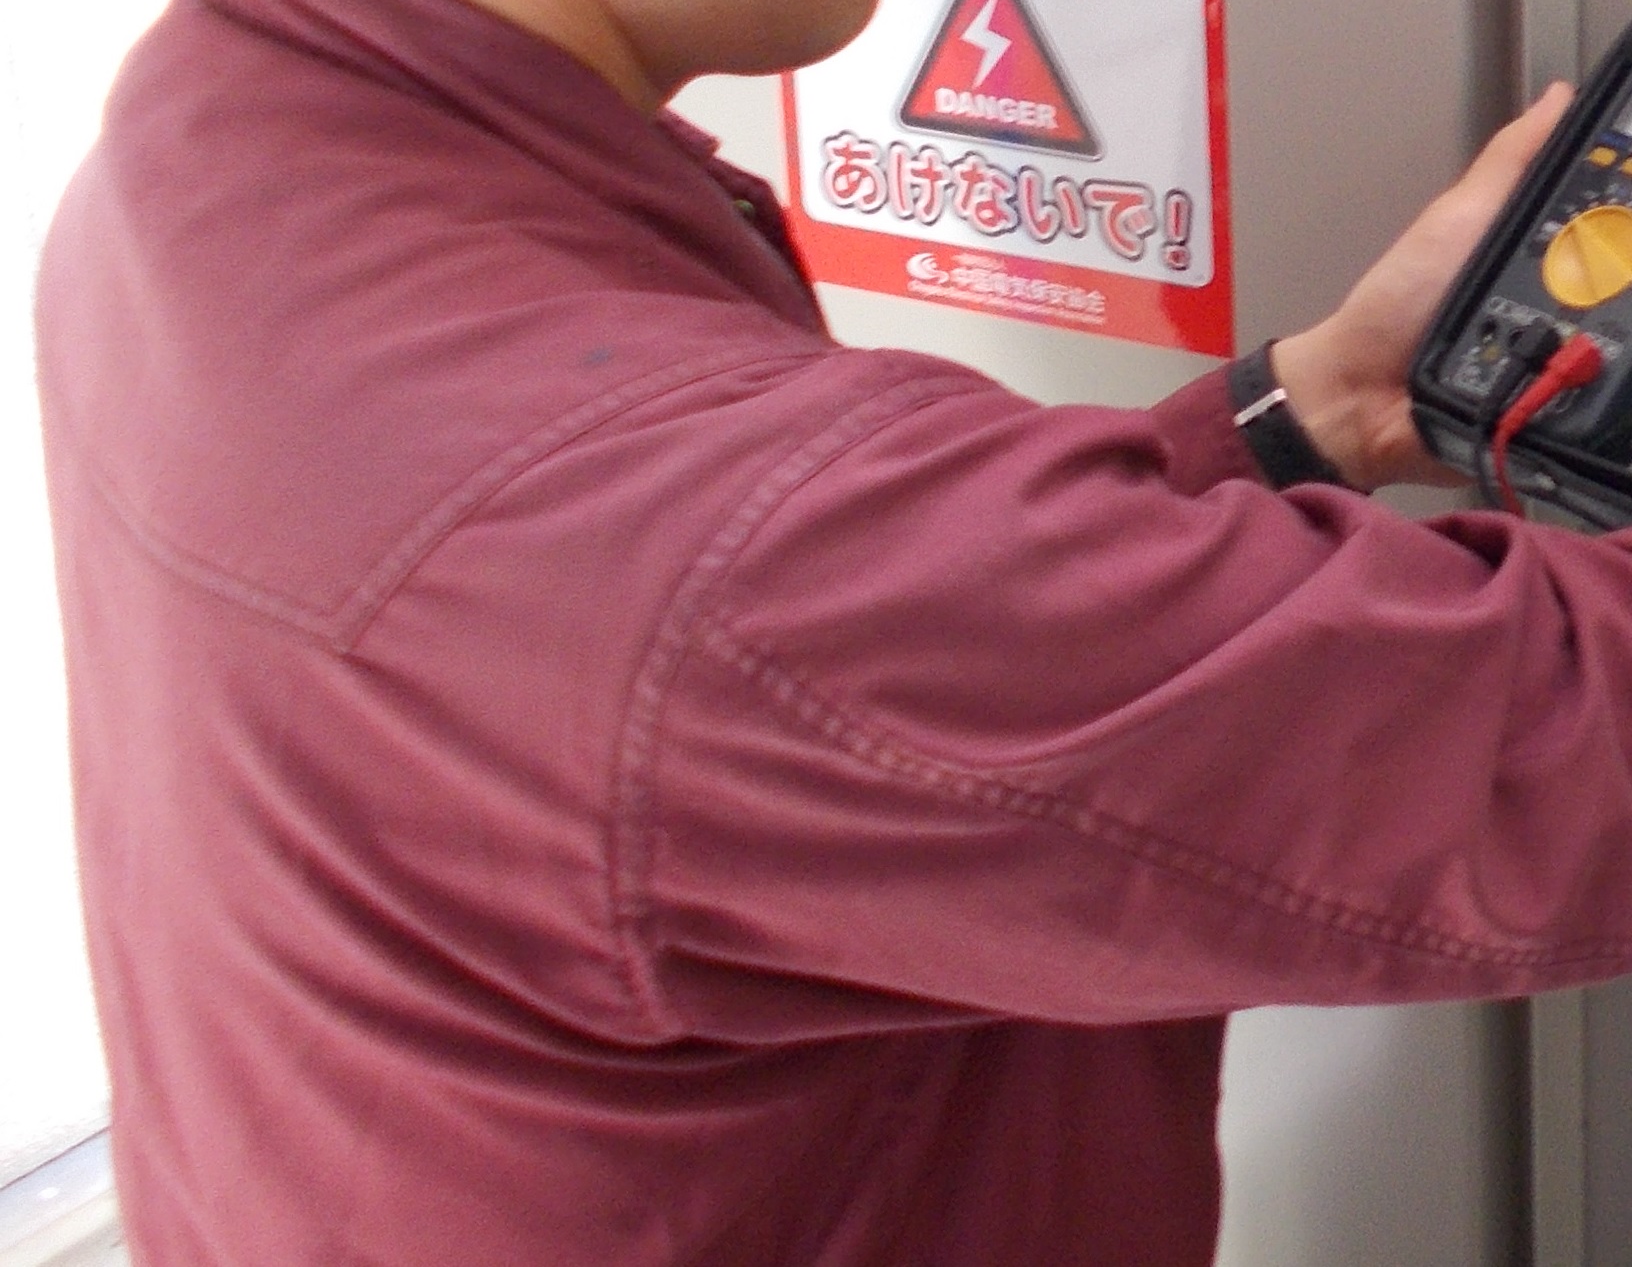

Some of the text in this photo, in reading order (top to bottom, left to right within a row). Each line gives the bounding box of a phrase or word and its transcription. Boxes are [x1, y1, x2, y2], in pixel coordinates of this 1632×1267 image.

[934, 86, 1060, 131] DANGER
[821, 130, 1193, 271] あけないで!
